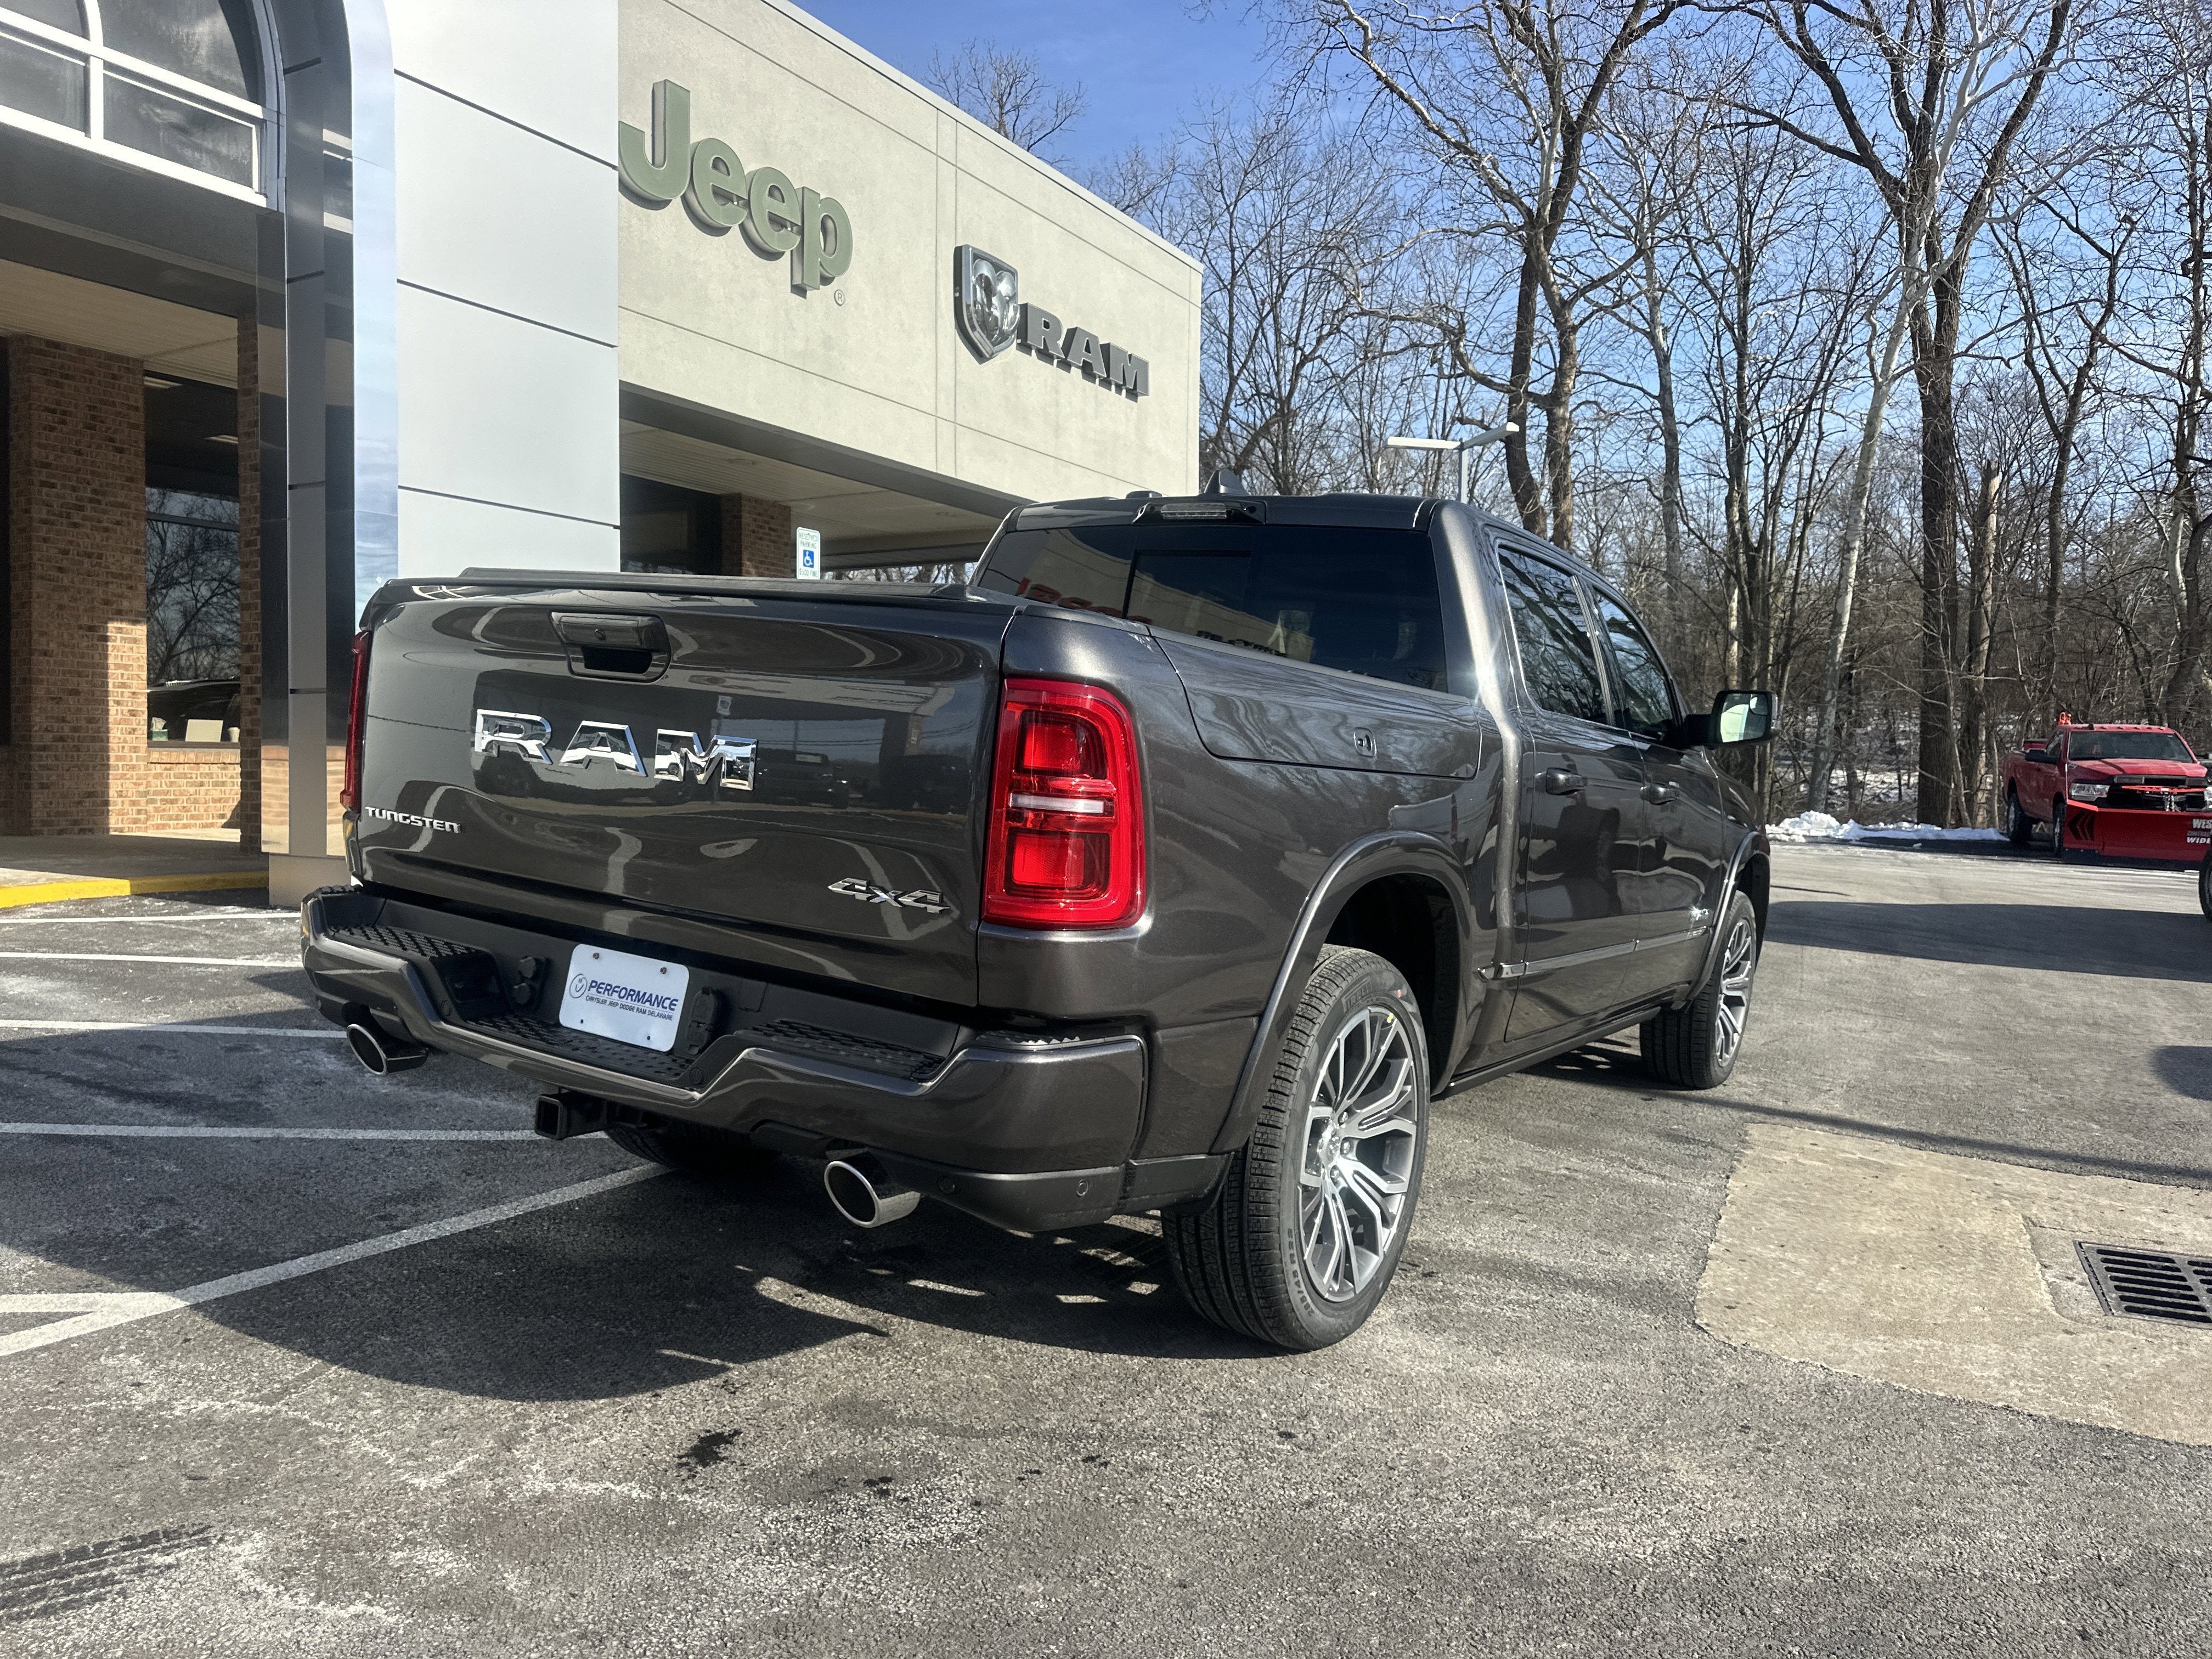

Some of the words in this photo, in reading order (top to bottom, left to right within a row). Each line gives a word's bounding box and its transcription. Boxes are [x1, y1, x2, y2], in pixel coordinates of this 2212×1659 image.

[618, 78, 853, 291] Jeep
[1018, 302, 1150, 396] RAM
[800, 540, 817, 549] PARKING
[475, 709, 758, 791] RAM
[365, 806, 462, 834] TUNGSTEN
[585, 995, 607, 1005] CHRYSLER
[619, 1003, 636, 1012] DODGE
[647, 1010, 673, 1021] DELAWARE
[588, 980, 679, 1011] PERFORMANCE
